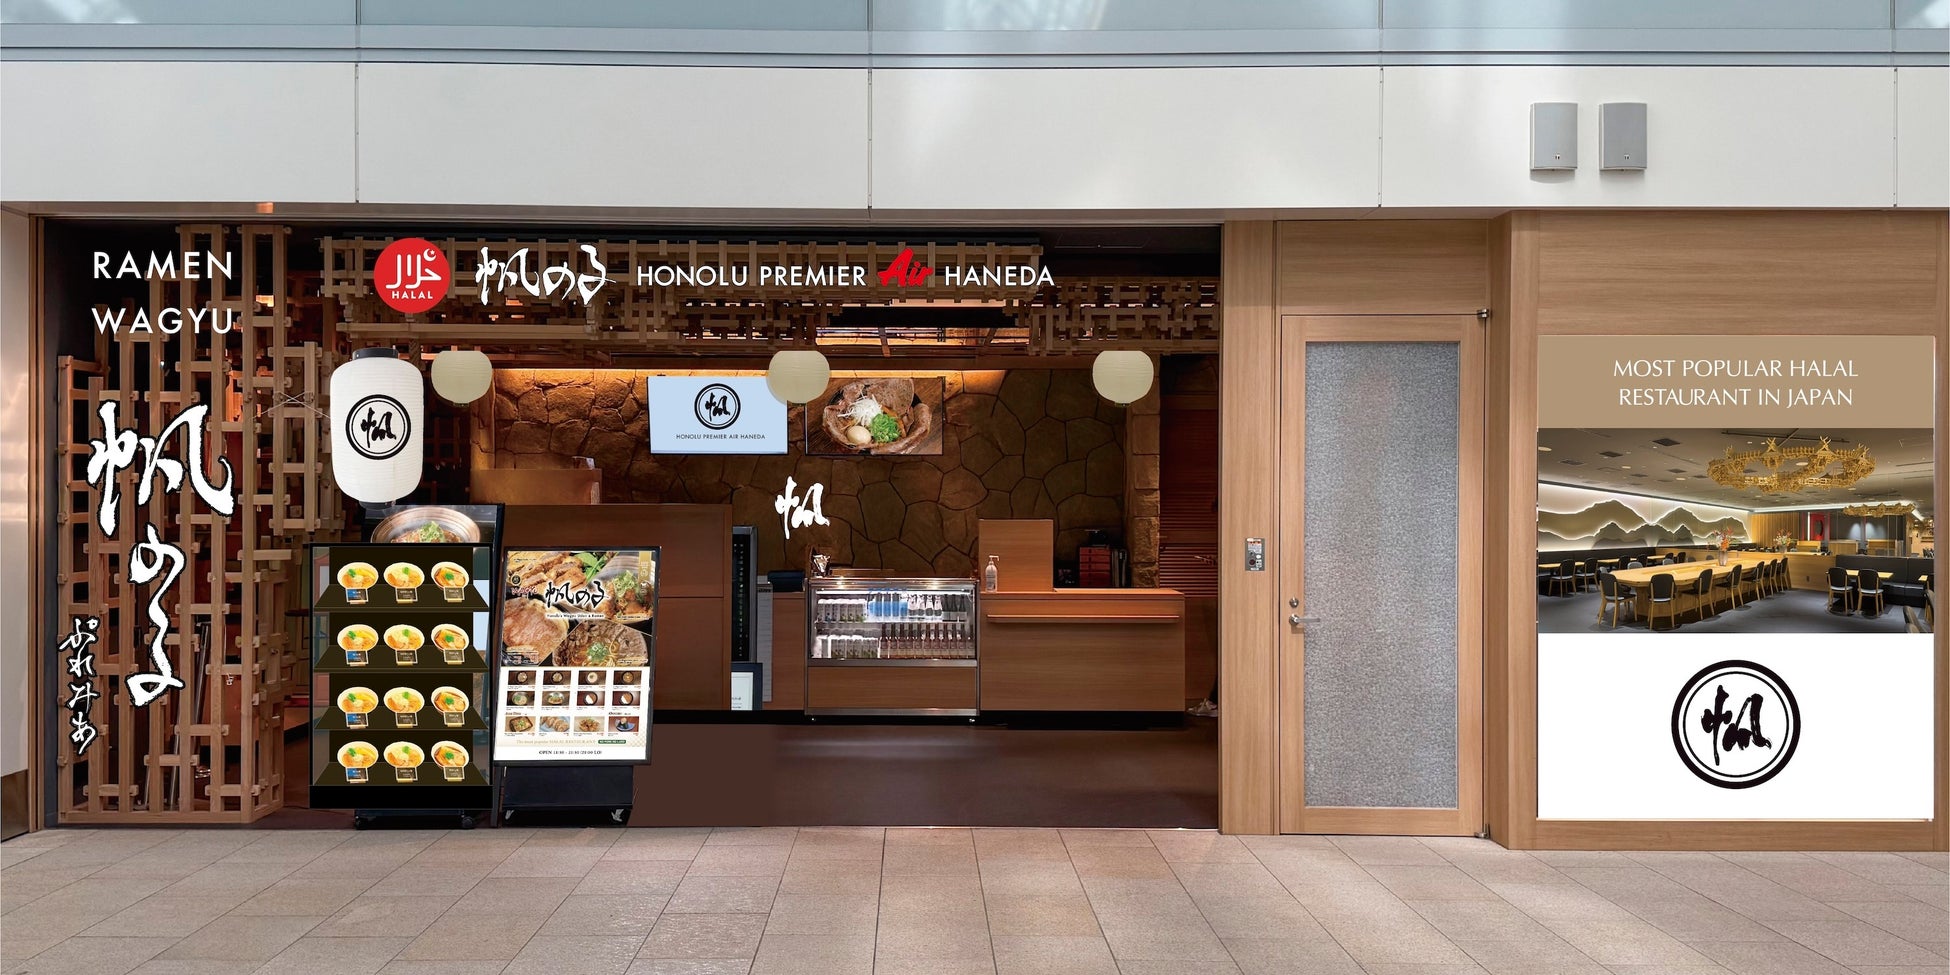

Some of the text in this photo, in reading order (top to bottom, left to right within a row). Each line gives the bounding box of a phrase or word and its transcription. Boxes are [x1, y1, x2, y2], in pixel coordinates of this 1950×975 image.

[94, 251, 232, 280] RAMEN
[637, 247, 1055, 286] HONOLU PREMIER Air HANEDA
[392, 291, 433, 299] HALAL
[92, 308, 232, 334] WAGYU
[1613, 359, 1858, 377] MOST POPULAR HALAL
[1619, 388, 1853, 409] RESTAURANT IN JAPAN
